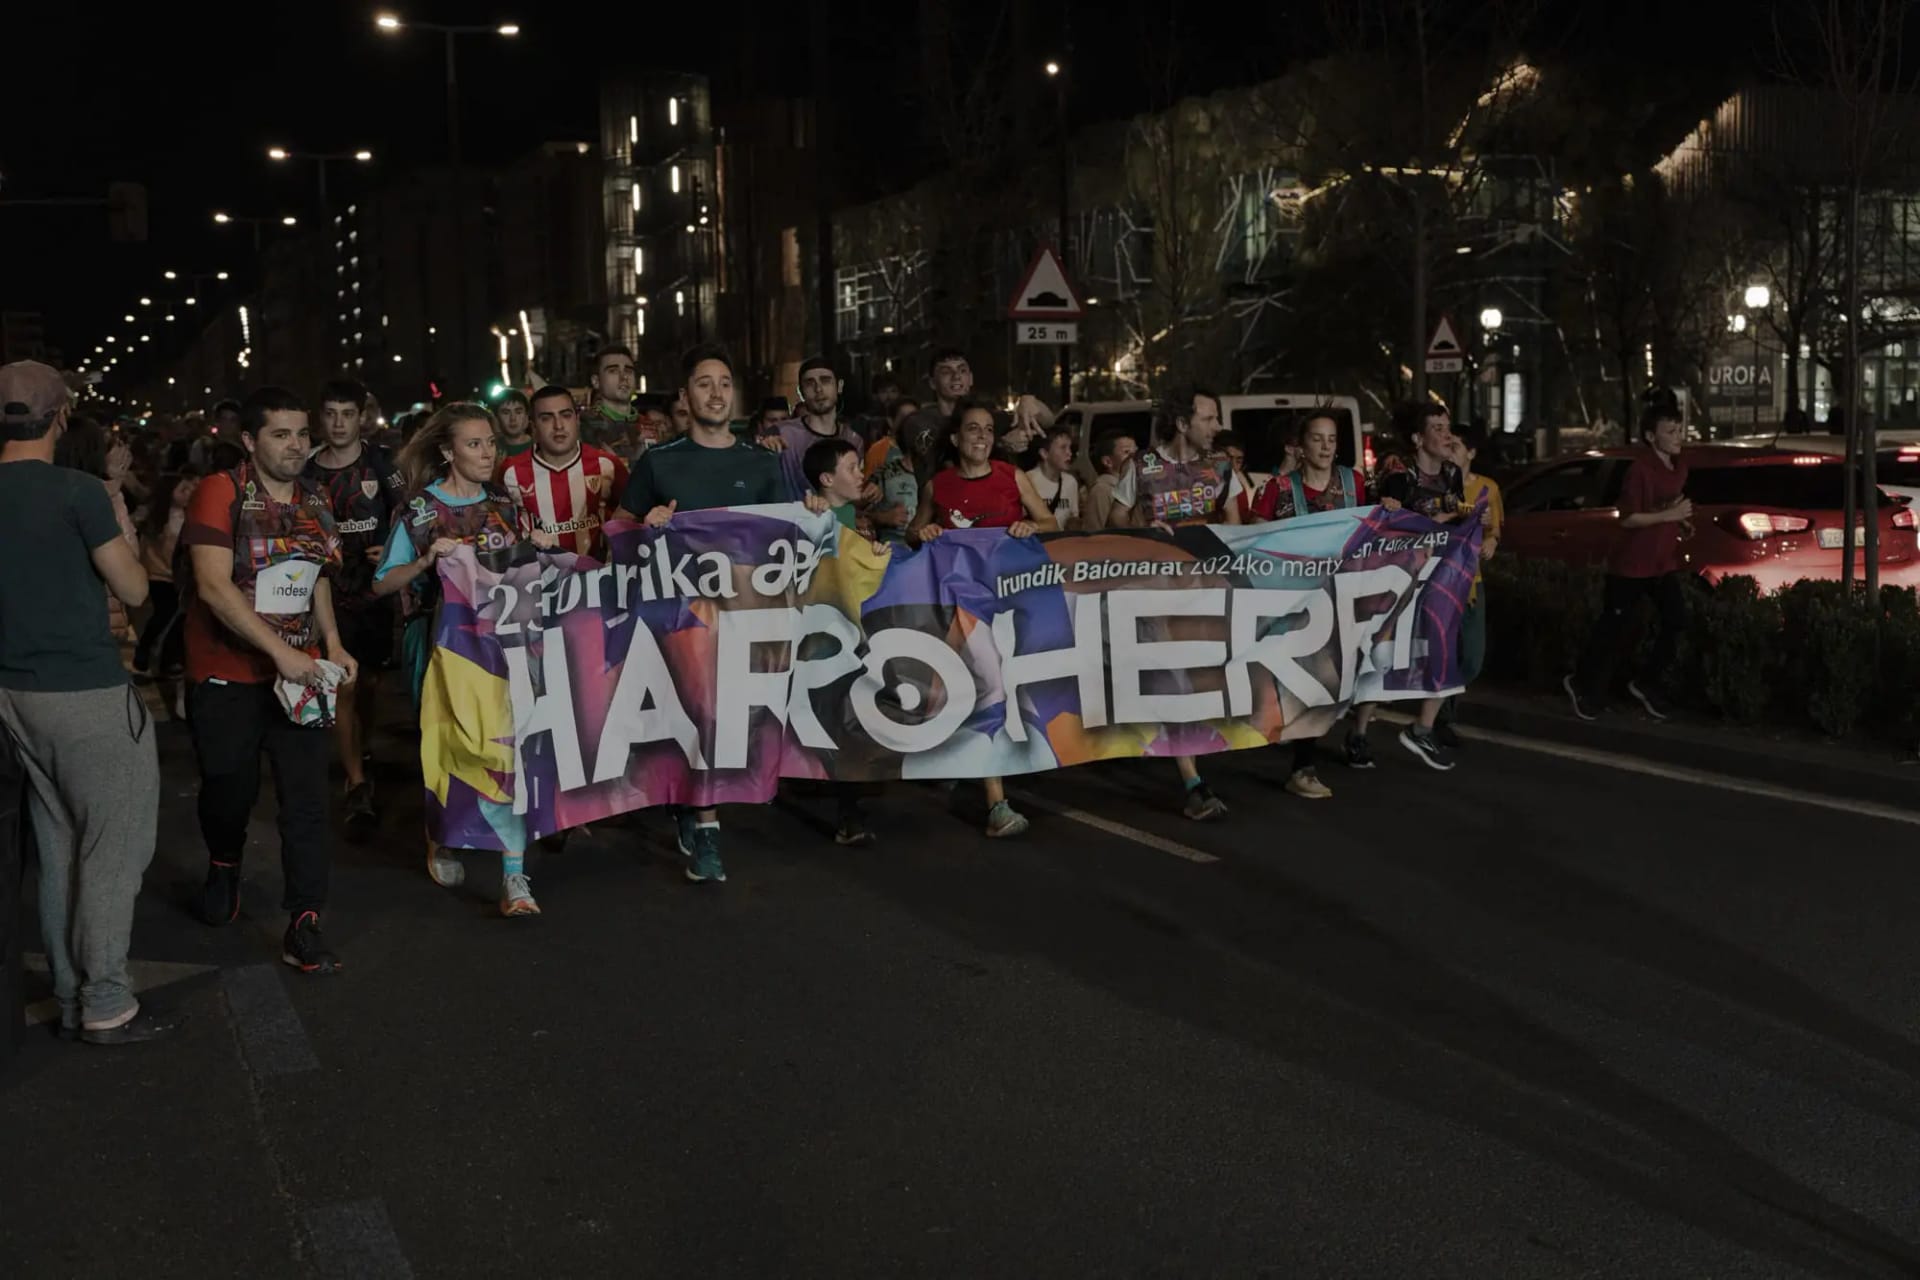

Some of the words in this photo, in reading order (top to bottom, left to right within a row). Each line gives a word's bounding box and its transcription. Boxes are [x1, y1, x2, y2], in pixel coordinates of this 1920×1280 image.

[1028, 327, 1047, 339] 25
[1056, 330, 1068, 339] m
[1708, 365, 1772, 385] UROPA
[337, 516, 379, 533] xabank
[996, 562, 1068, 599] Irundik
[1073, 560, 1183, 583] Baionarat
[1190, 553, 1274, 576] 2024ko
